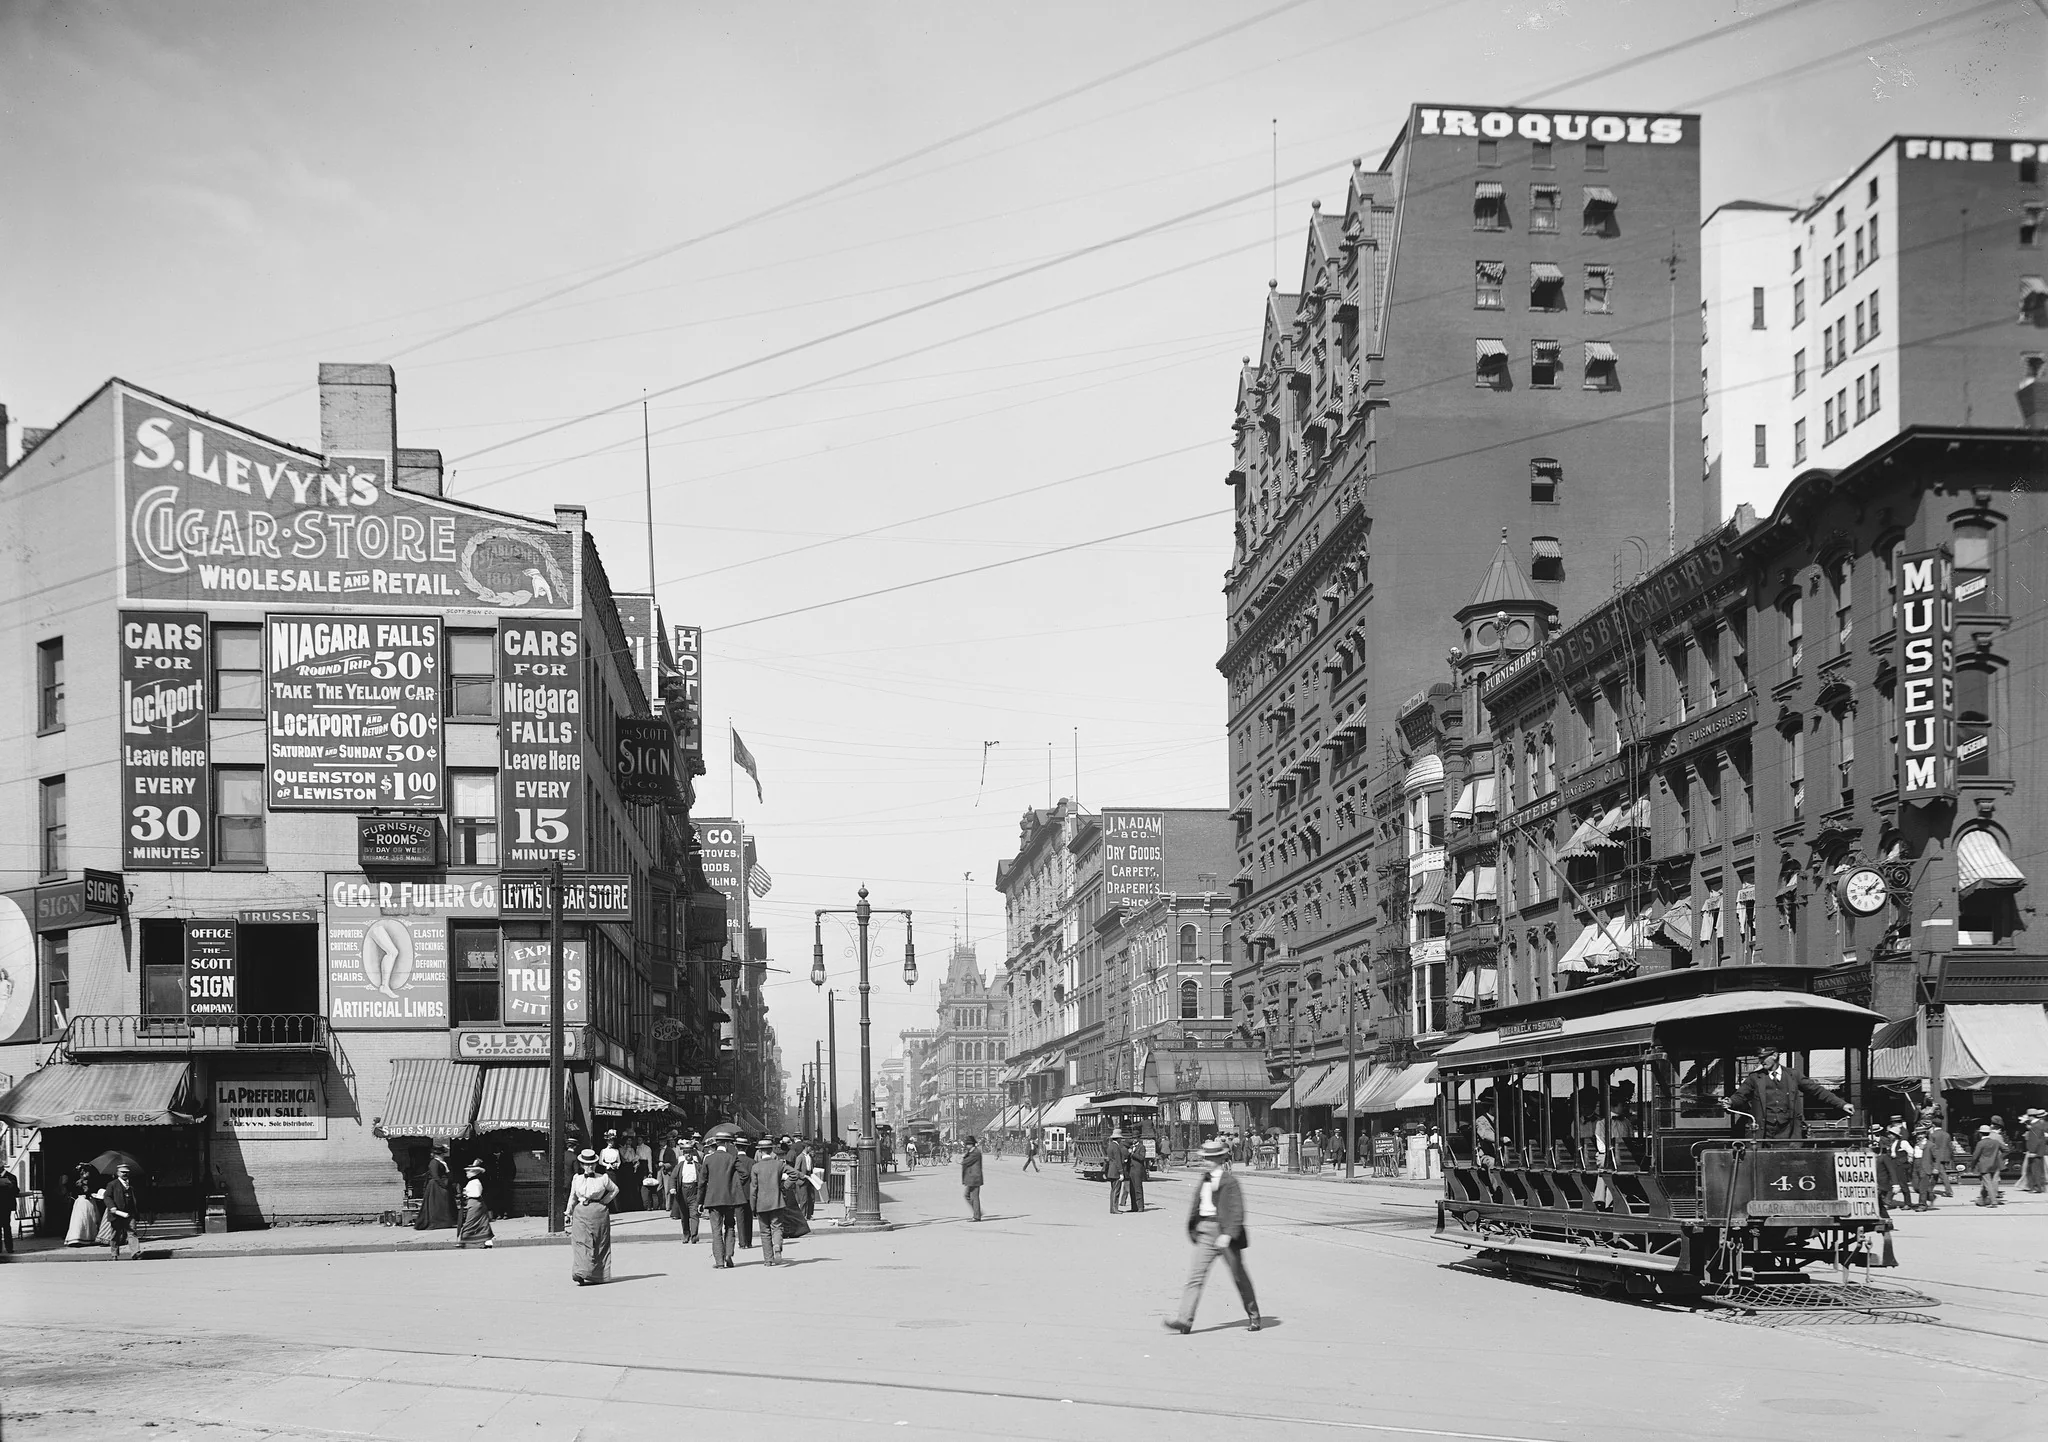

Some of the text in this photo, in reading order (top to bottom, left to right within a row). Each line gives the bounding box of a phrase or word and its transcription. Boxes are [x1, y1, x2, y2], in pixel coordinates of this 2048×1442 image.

[1420, 108, 1683, 144] IROQUOIS
[1905, 139, 1994, 162] FIRE
[131, 485, 457, 574] CIGAR STORE
[198, 564, 462, 597] WHOLESALE AND RETAIL.
[124, 622, 202, 651] CARS
[504, 630, 577, 657] CARS
[271, 622, 435, 674] NIAGARA FALLS
[134, 656, 193, 670] FOR
[295, 664, 342, 676] ROUND
[340, 657, 372, 674] TRIP
[513, 663, 568, 676] FOR
[1485, 649, 1538, 692] FURNISHERS
[1902, 558, 1937, 792] MUSEUM
[1939, 558, 1954, 791] MUSEUM
[273, 682, 435, 701] TAKE THE YELLOW CAR
[123, 679, 204, 735] Lockport
[503, 682, 579, 720] Niagara
[272, 710, 362, 738] LOCKPORT
[362, 722, 389, 736] RETURN
[366, 715, 383, 726] AND
[511, 721, 573, 744] FALLS
[635, 727, 668, 741] SCOTT
[125, 745, 205, 767] Leave Here
[272, 743, 324, 758] SATURDAY
[324, 748, 338, 757] AND
[338, 744, 384, 759] SUNDAY
[618, 738, 670, 776] SIGN
[1565, 776, 1596, 799] HATTERS
[1688, 706, 1748, 745] FURNISHERS
[504, 750, 580, 771] Leave Here
[273, 768, 376, 784] QUEENSTON
[135, 777, 196, 795] EVERY
[276, 788, 291, 798] OR
[293, 785, 377, 800] LEWISTON
[515, 781, 571, 799] EVERY
[130, 805, 201, 842] 30
[362, 822, 431, 838] FURNISHED
[514, 808, 570, 844] 15
[376, 834, 418, 845] ROOMS
[707, 829, 737, 845] CO.
[1131, 831, 1149, 839] CO.
[133, 846, 201, 859] MINUTES
[511, 848, 577, 861] MINUTES
[1106, 844, 1126, 861] DRY
[86, 879, 119, 905] SIGNS
[332, 881, 497, 909] GEO. R. FULLER CO.
[502, 881, 629, 910] LEVYN'S CGAR STORE
[39, 893, 81, 918] SIGN
[242, 911, 315, 922] TRUSSES.
[191, 928, 232, 939] OFFICE
[413, 929, 445, 939] ELASTIC
[190, 957, 233, 970] SCOTT
[331, 959, 447, 969] INVALID DEFORMITY
[331, 972, 366, 982] CHAIRS.
[507, 968, 581, 992] TRUS
[189, 975, 235, 998] SIGN
[190, 1003, 235, 1014] COMPANY.
[332, 997, 447, 1018] ARTIFICIAL LIMBS.
[654, 1024, 678, 1038] SIGN
[1520, 1023, 1532, 1034] ELK
[218, 1087, 317, 1104] LA PREFERENCIA
[74, 1113, 120, 1122] GREGORY
[230, 1107, 308, 1118] NOW ON SALE.
[499, 1120, 529, 1128] NIAGARA
[1837, 1155, 1874, 1168] COURT
[1769, 1175, 1817, 1191] 46
[1838, 1170, 1875, 1183] NIAGARA
[1839, 1186, 1876, 1199] FOURTEENTH
[1750, 1201, 1849, 1214] NIAGARA CONNECTICUT
[1853, 1201, 1877, 1216] UTICA
